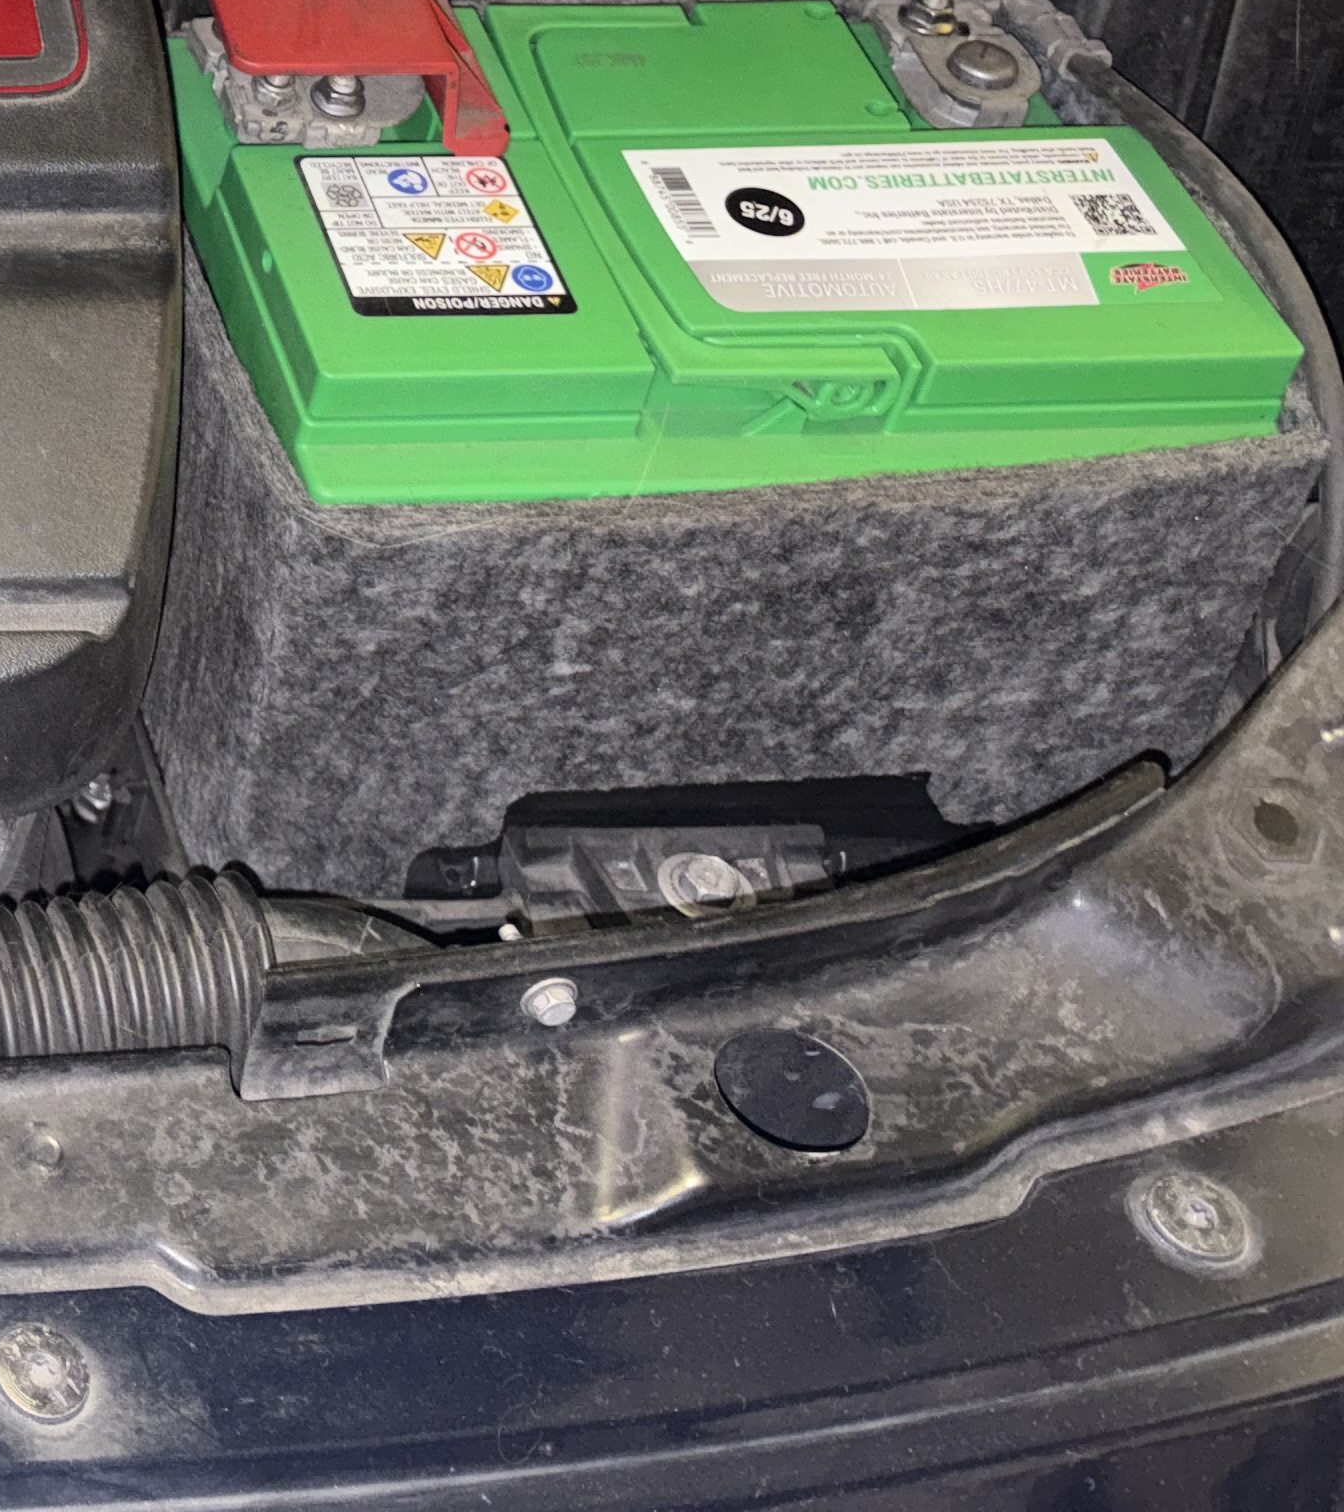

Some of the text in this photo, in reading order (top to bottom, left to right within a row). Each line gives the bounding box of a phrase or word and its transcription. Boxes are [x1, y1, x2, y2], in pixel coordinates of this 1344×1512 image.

[806, 168, 1114, 190] INTERSTATEBATTERIES.COM
[938, 195, 1050, 207] Dallas, TX 75254 USA
[739, 201, 794, 226] 6/25
[881, 209, 928, 218] Batteries
[931, 208, 982, 217] Interstate
[985, 207, 996, 215] by
[1000, 205, 1057, 214] Distributed
[1113, 267, 1179, 275] BATTERIES
[708, 271, 891, 282] 24-MONTH FREE REPLACEMENT
[1112, 274, 1186, 283] INTERSTATE
[1045, 277, 1075, 291] MT
[357, 286, 415, 294] EXPLOSIVE
[761, 281, 898, 298] AUTOMOTIVE
[413, 295, 543, 309] DANGER/POISON
